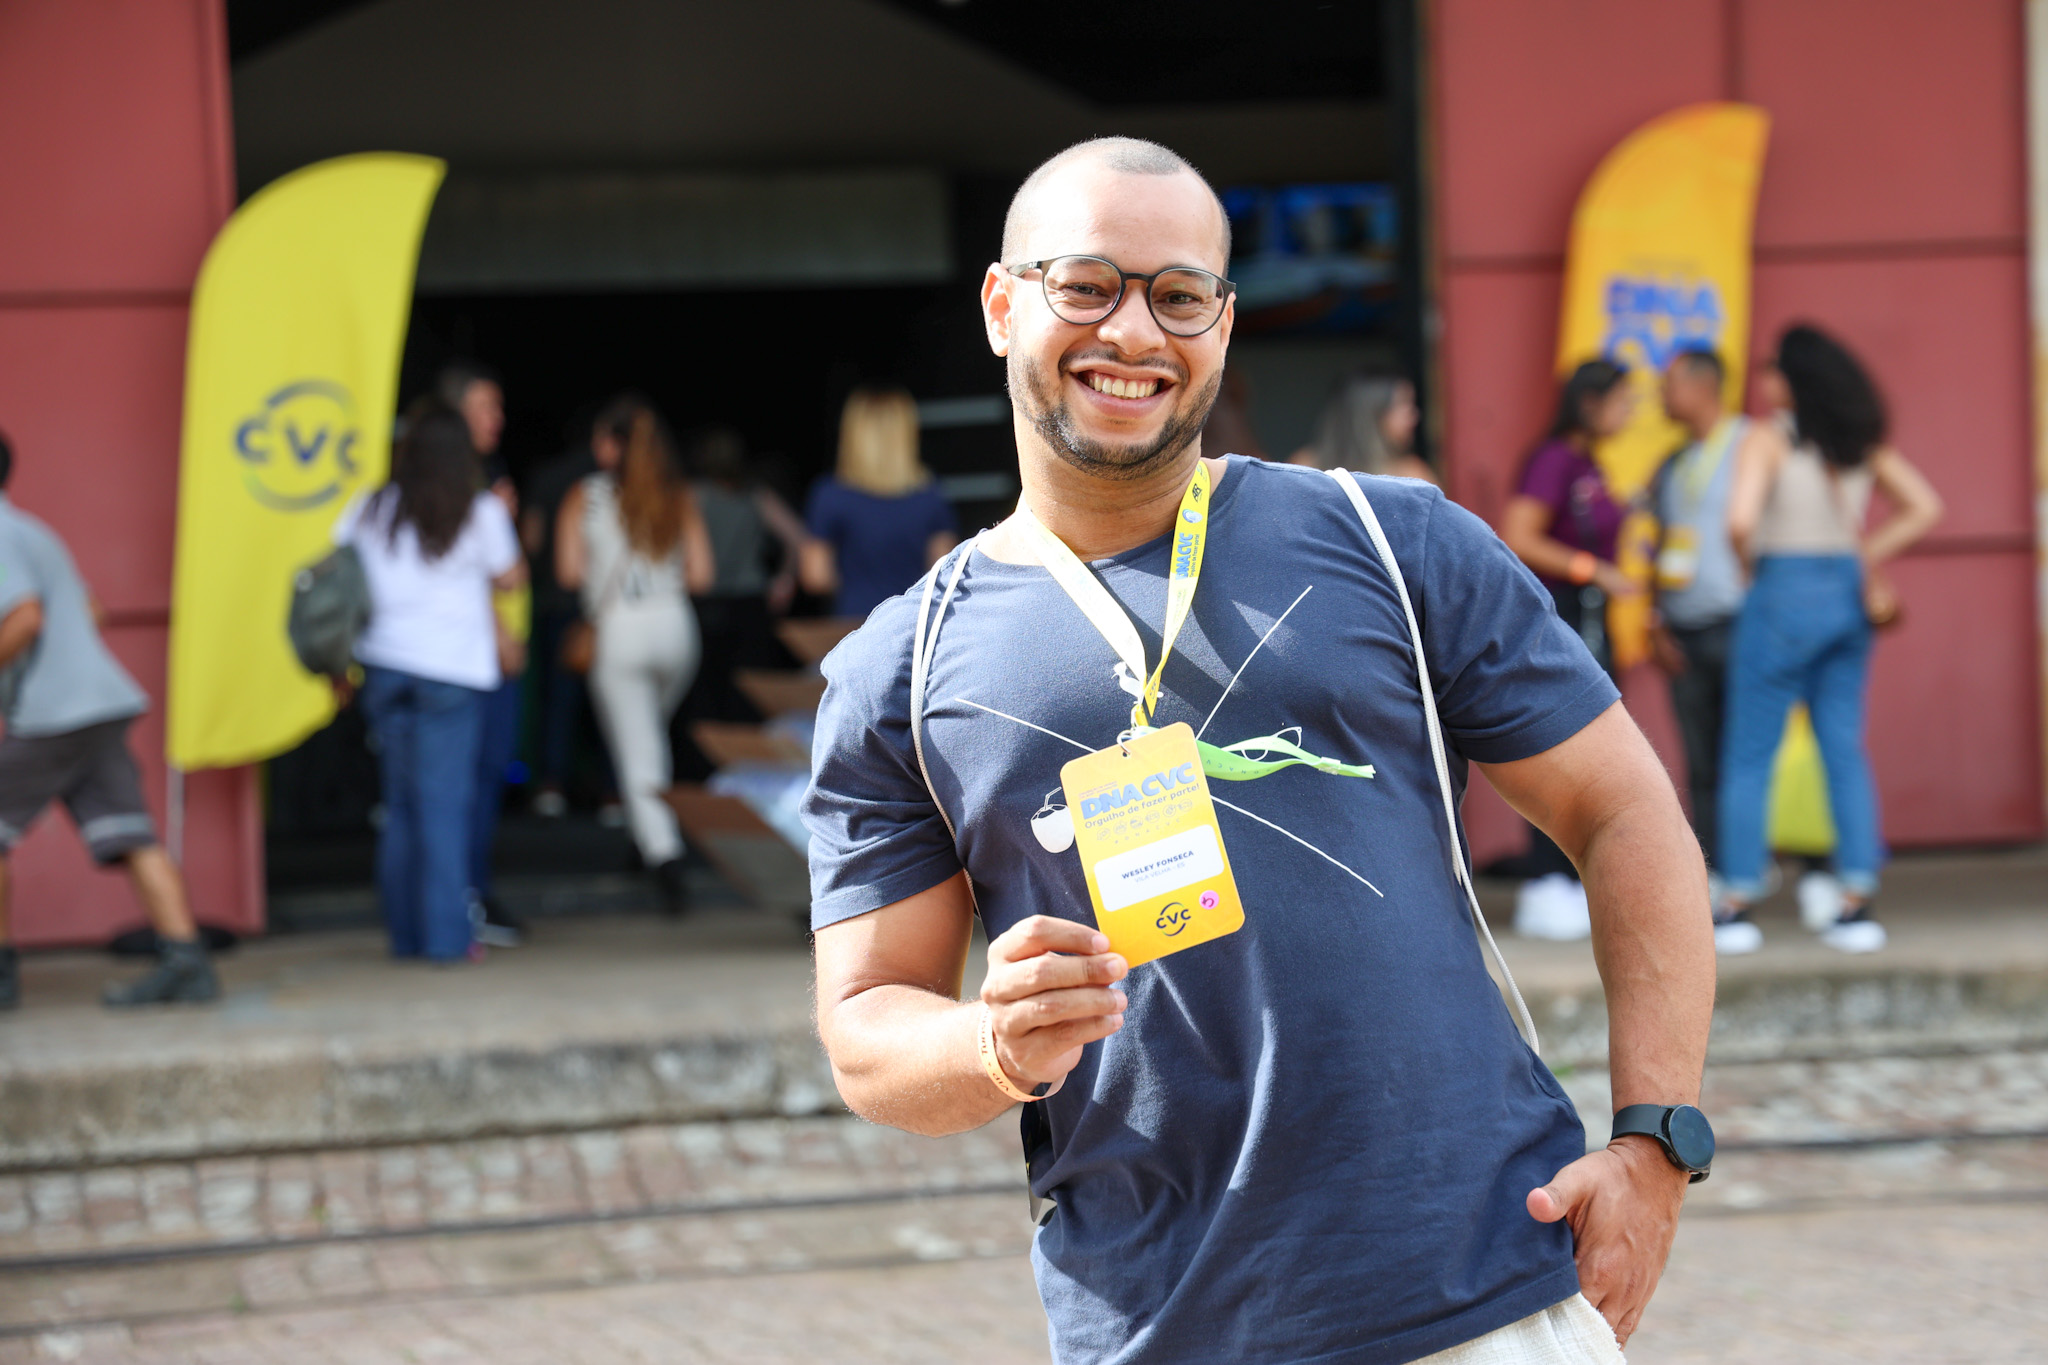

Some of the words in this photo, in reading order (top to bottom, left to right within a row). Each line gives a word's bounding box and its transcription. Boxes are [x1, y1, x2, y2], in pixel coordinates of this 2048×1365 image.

[235, 417, 358, 475] CVC
[1177, 532, 1194, 555] CVC
[1175, 554, 1191, 581] DNA
[1080, 783, 1144, 820] DNA
[1141, 762, 1196, 797] CVC
[1084, 810, 1125, 829] Orgulho
[1127, 804, 1140, 815] de
[1141, 795, 1168, 809] fazer
[1170, 783, 1200, 802] parte!
[1121, 863, 1154, 880] WESLEY
[1156, 850, 1195, 868] FONSECA
[1155, 908, 1192, 930] CVC
